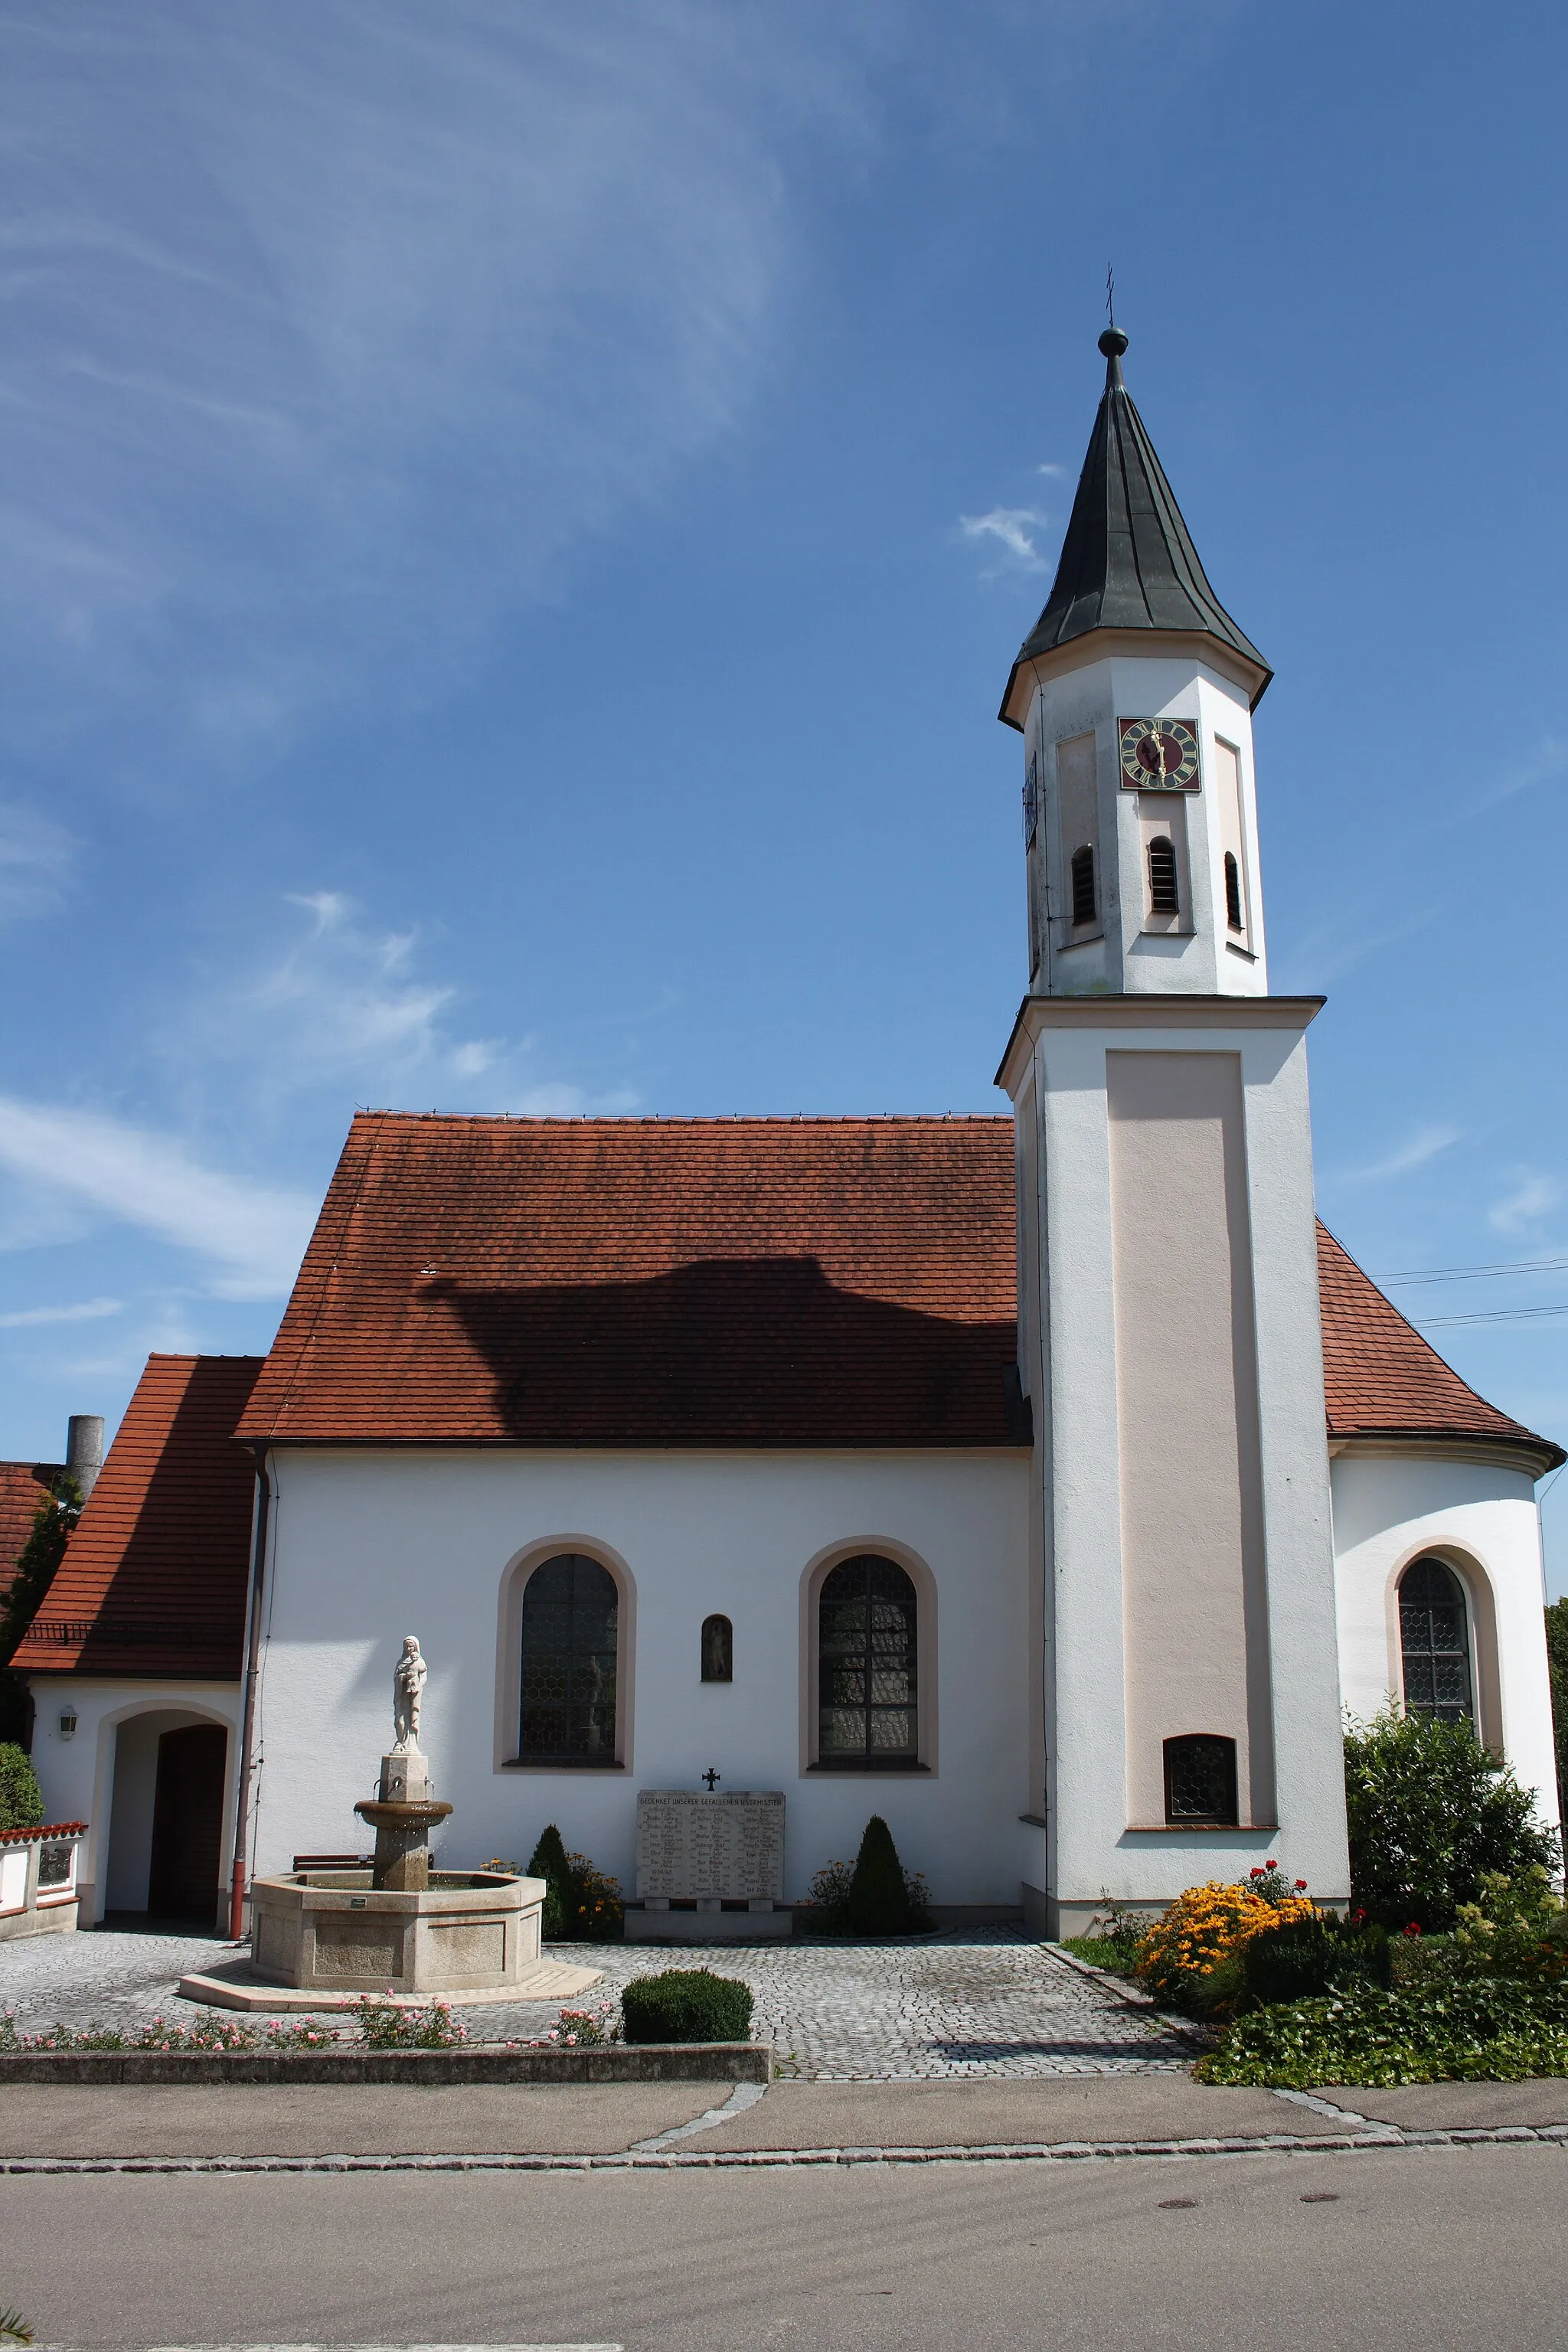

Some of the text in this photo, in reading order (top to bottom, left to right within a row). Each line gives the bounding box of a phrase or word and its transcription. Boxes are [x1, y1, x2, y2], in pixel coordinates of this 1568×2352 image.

[1135, 722, 1150, 735] XI
[1151, 720, 1165, 732] XII
[1170, 723, 1179, 737] I
[1124, 732, 1139, 746] X
[1179, 735, 1193, 746] II
[1122, 747, 1135, 758] IX
[1184, 750, 1197, 760] III
[1138, 771, 1150, 786] VII
[1173, 773, 1184, 786] V
